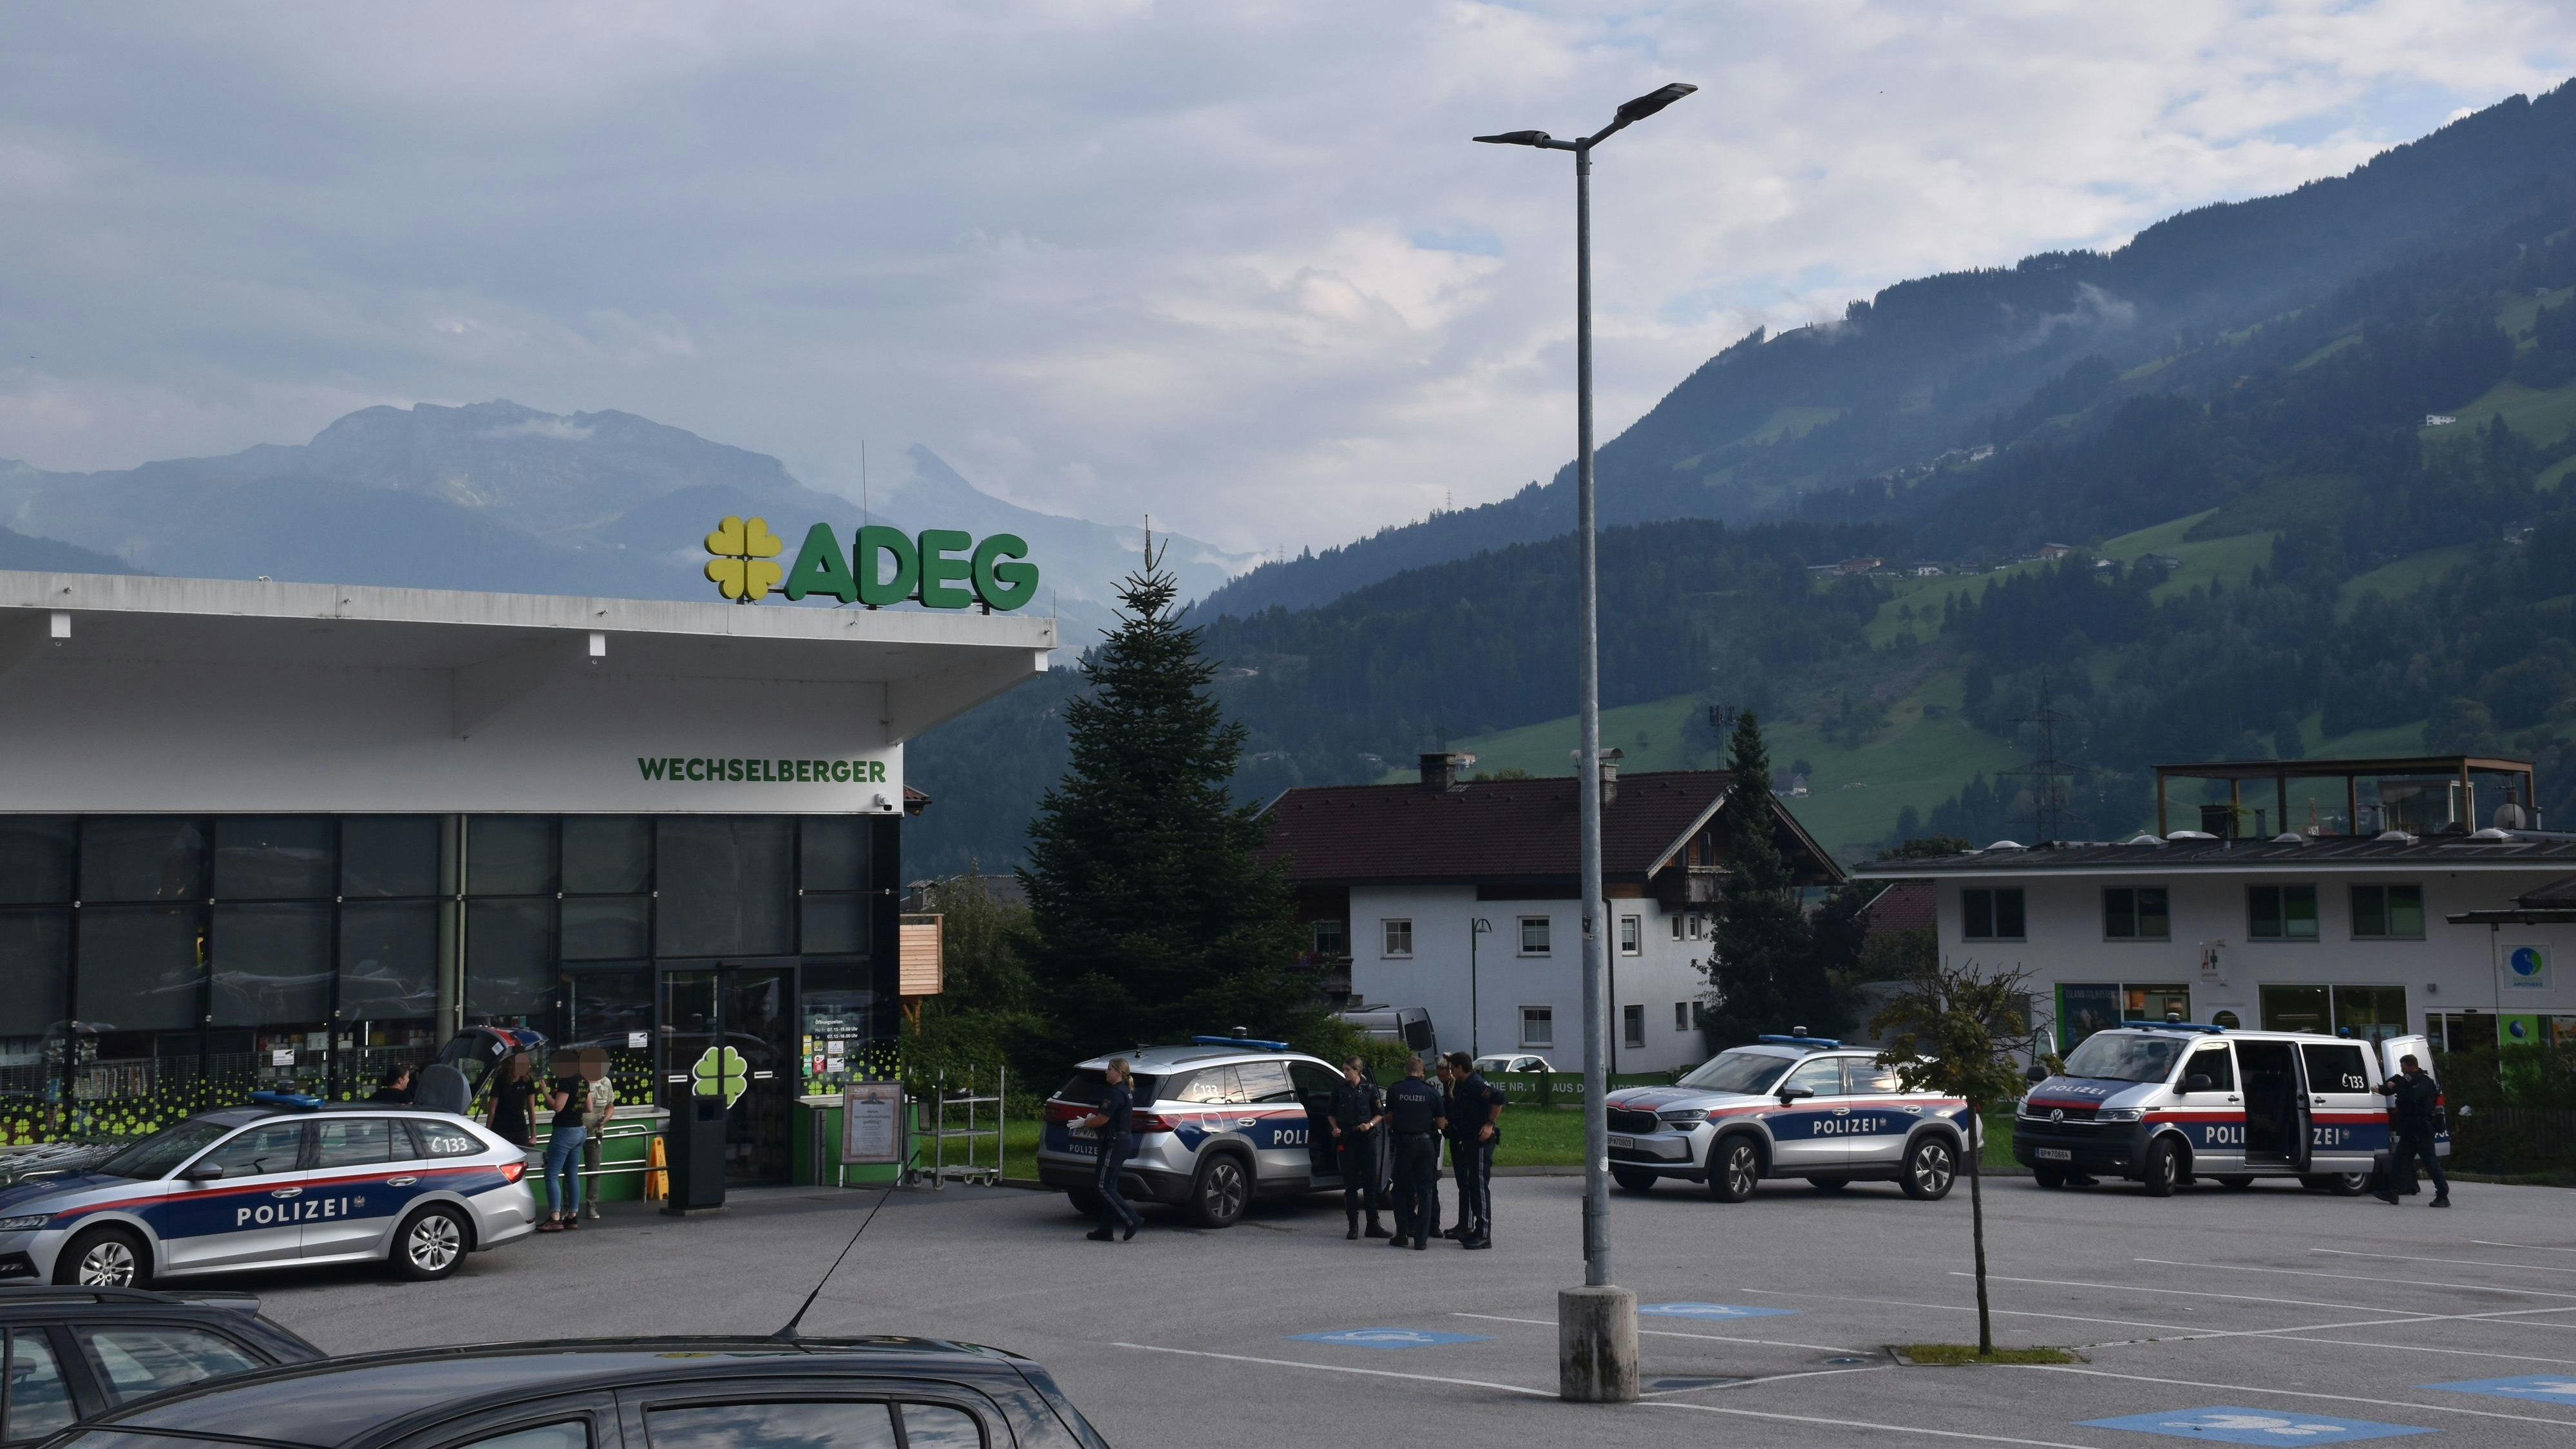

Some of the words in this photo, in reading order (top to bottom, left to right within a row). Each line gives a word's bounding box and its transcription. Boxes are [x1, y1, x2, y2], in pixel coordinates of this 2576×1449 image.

[784, 522, 1039, 611] ADEG
[638, 757, 886, 782] WECHSELBERGER
[1509, 1083, 1526, 1092] NR.
[1530, 1083, 1535, 1092] 1
[1551, 1083, 1573, 1093] AUS
[2348, 1075, 2364, 1089] 133
[1200, 1084, 1218, 1097] 133
[2046, 1085, 2106, 1095] POLIZEI
[1813, 1118, 1876, 1134] POLIZEI
[1274, 1130, 1308, 1144] POLI
[2205, 1126, 2245, 1143] POLI
[2312, 1128, 2339, 1144] ZEI
[442, 1137, 468, 1152] 133
[1069, 1144, 1097, 1154] POLIZE
[237, 1197, 347, 1226] POLIZEI
